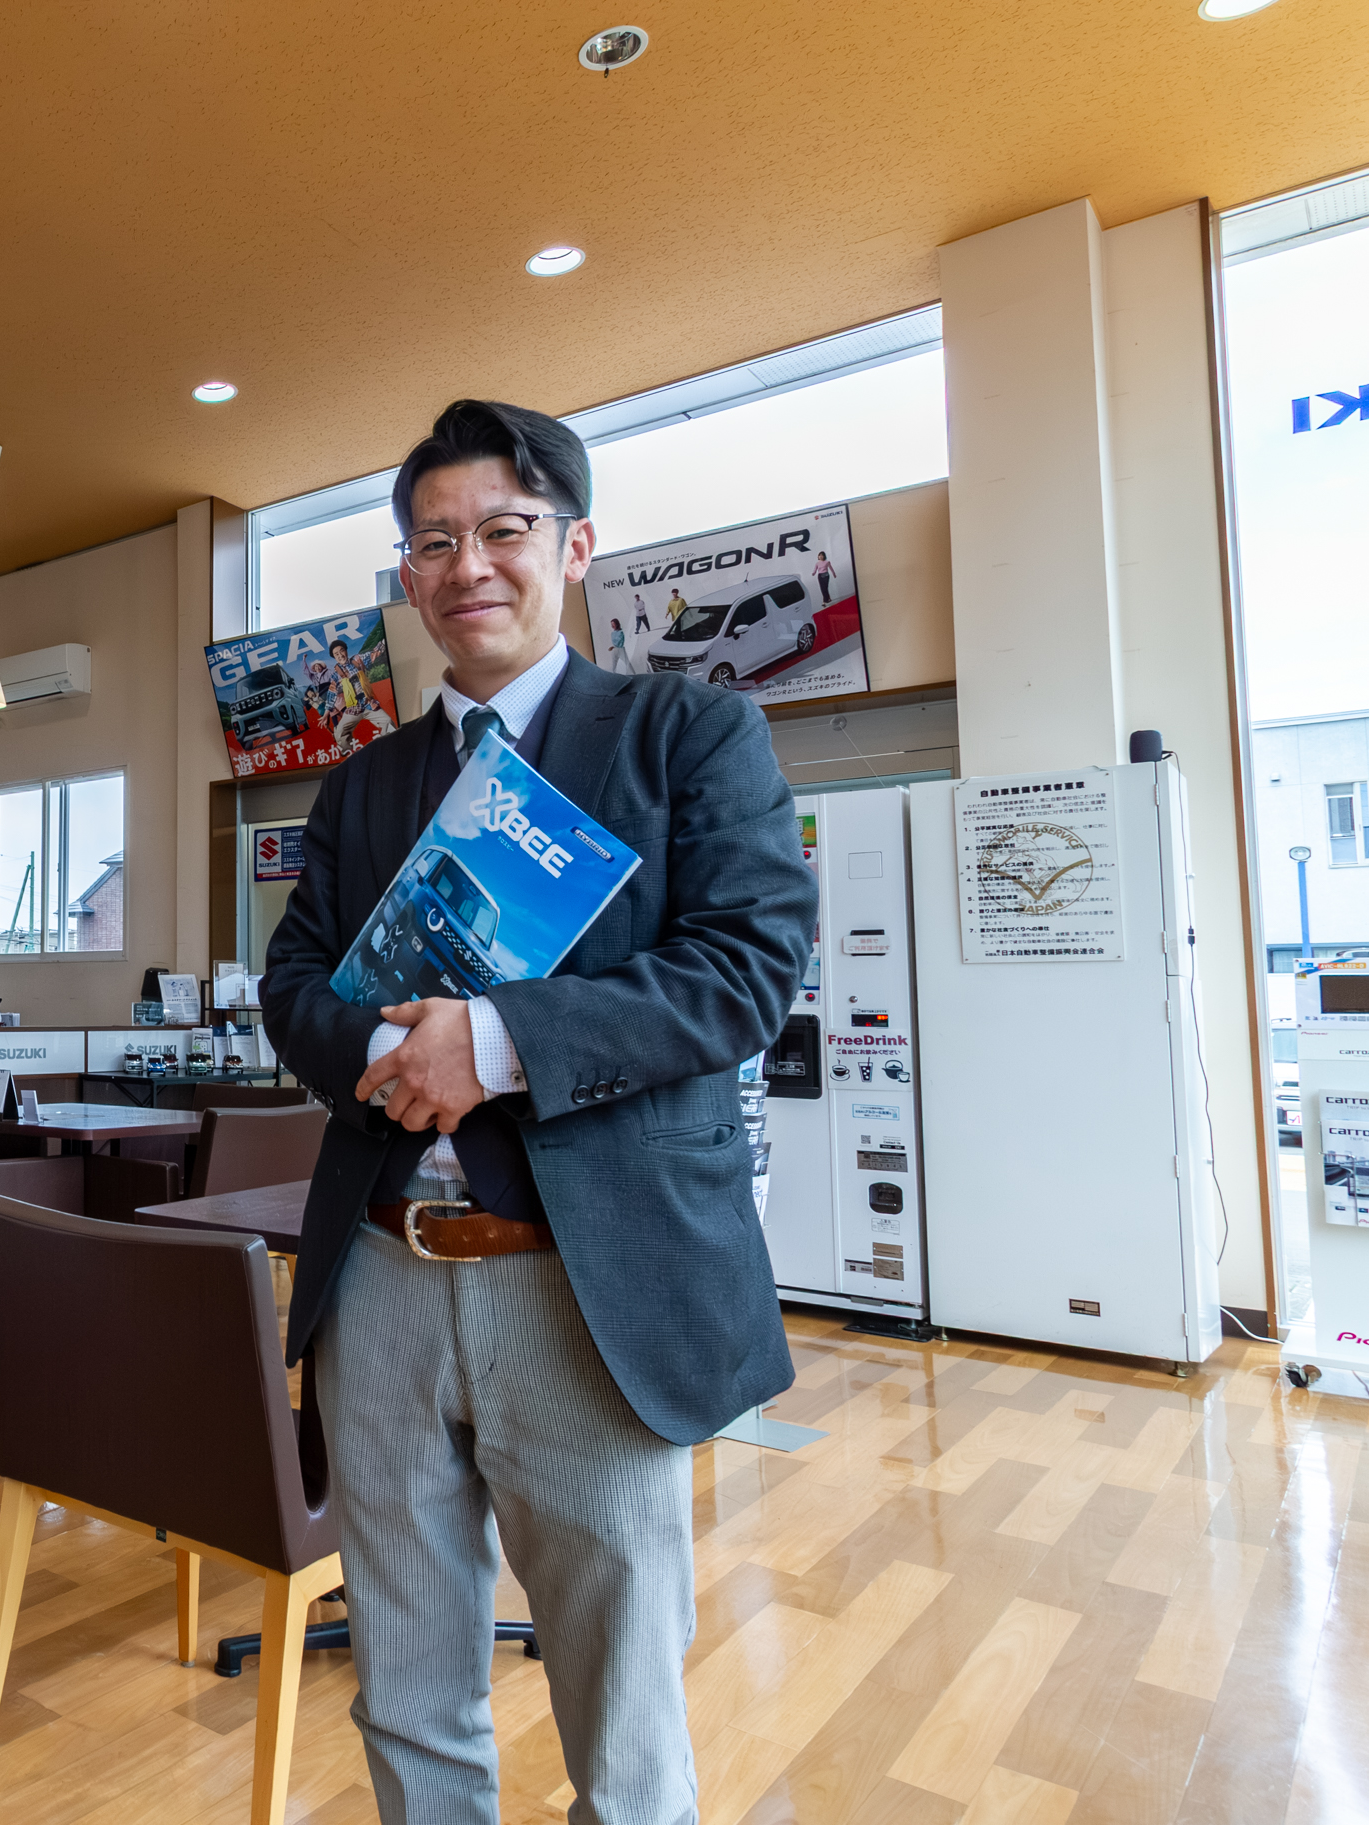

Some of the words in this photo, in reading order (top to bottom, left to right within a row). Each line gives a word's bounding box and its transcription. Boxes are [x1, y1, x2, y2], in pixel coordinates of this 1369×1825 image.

[603, 578, 625, 590] NEW
[207, 640, 254, 665] SPACIA
[210, 615, 364, 688] GEAR
[469, 777, 574, 879] XBEE
[1041, 825, 1081, 849] SERVICE
[137, 1045, 176, 1055] SUZUKI
[828, 1035, 909, 1046] FreeDrink
